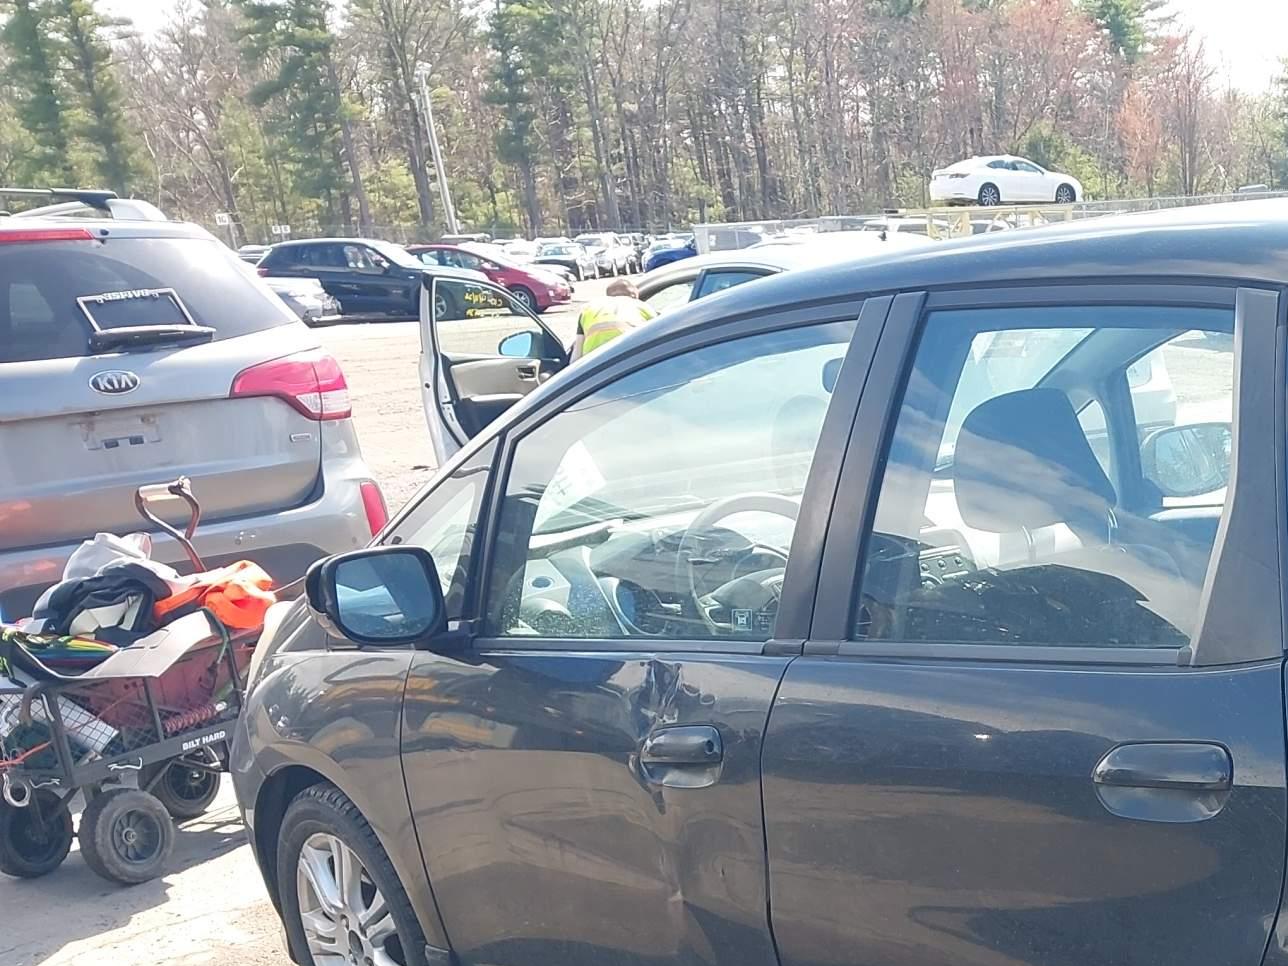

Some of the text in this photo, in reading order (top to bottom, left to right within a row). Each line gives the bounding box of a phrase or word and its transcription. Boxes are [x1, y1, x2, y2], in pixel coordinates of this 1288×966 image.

[96, 373, 134, 391] KIA
[182, 730, 226, 751] BILT HARD
